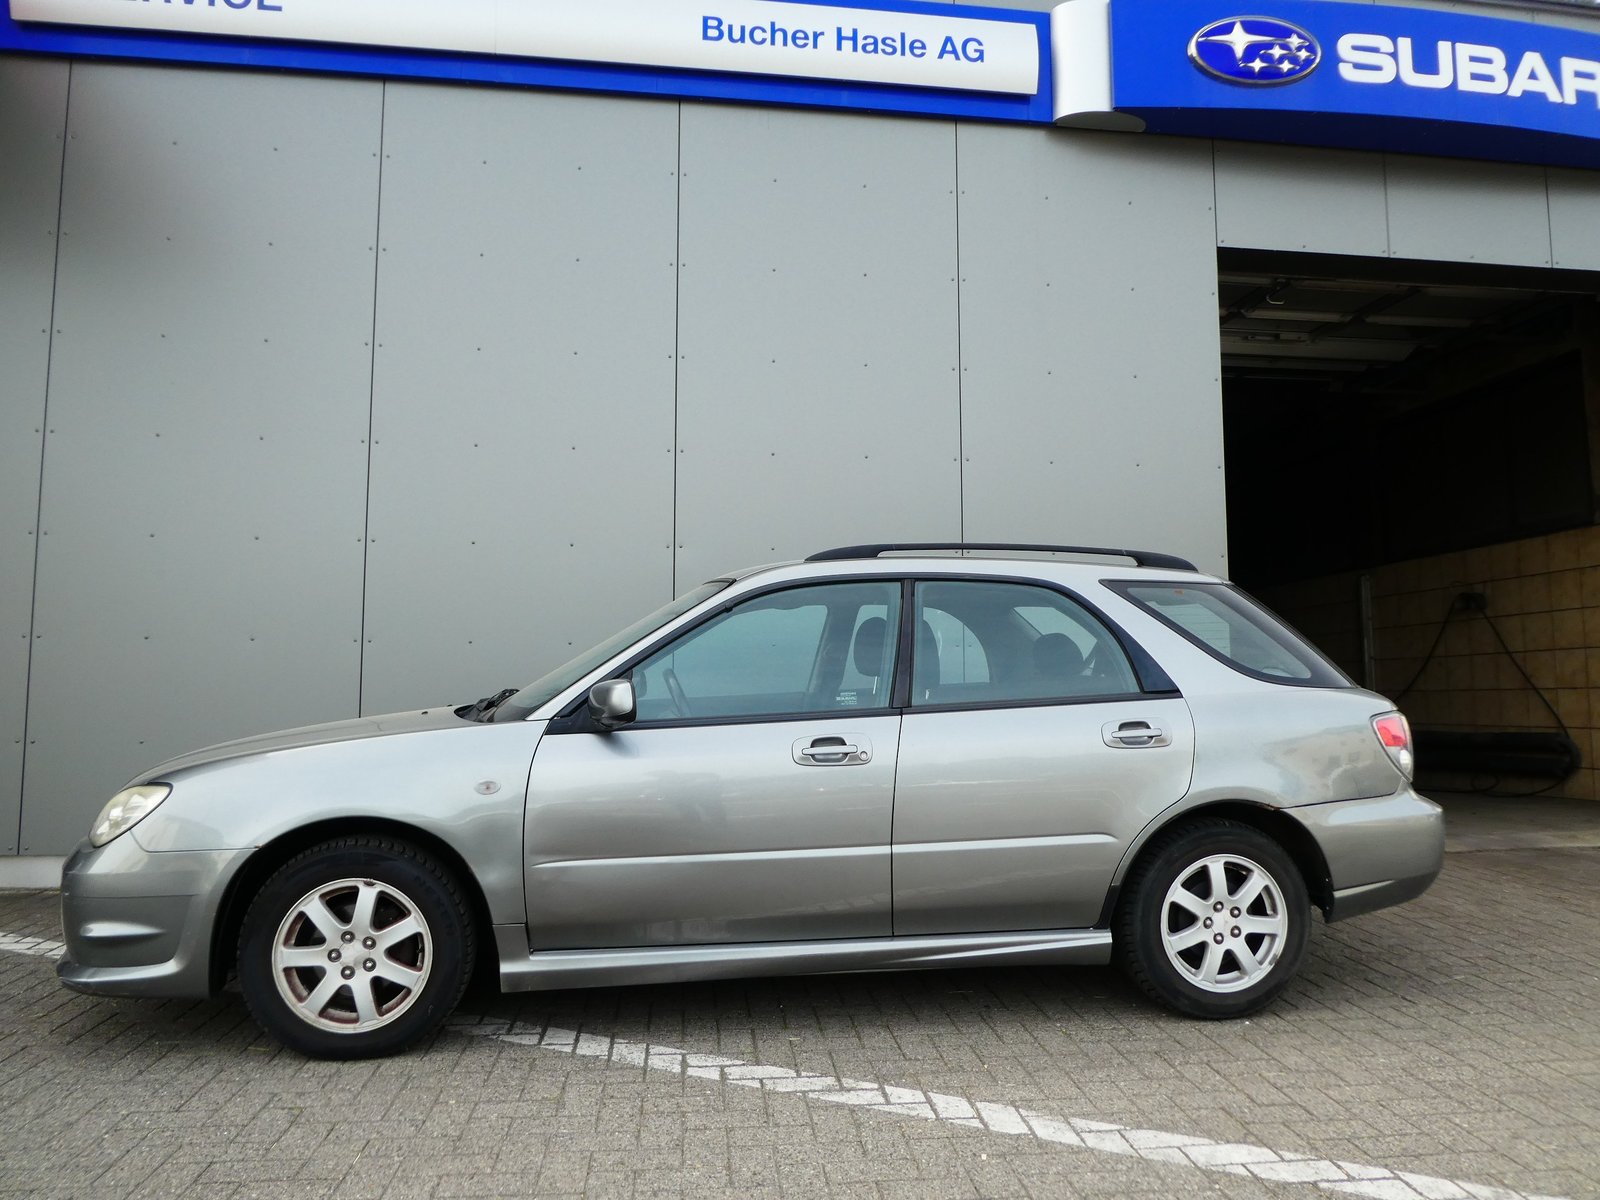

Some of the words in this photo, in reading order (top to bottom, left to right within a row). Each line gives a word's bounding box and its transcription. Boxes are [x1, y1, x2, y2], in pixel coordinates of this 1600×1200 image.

[701, 15, 825, 49] Bucher
[835, 26, 927, 58] Hasle
[936, 35, 985, 63] AG
